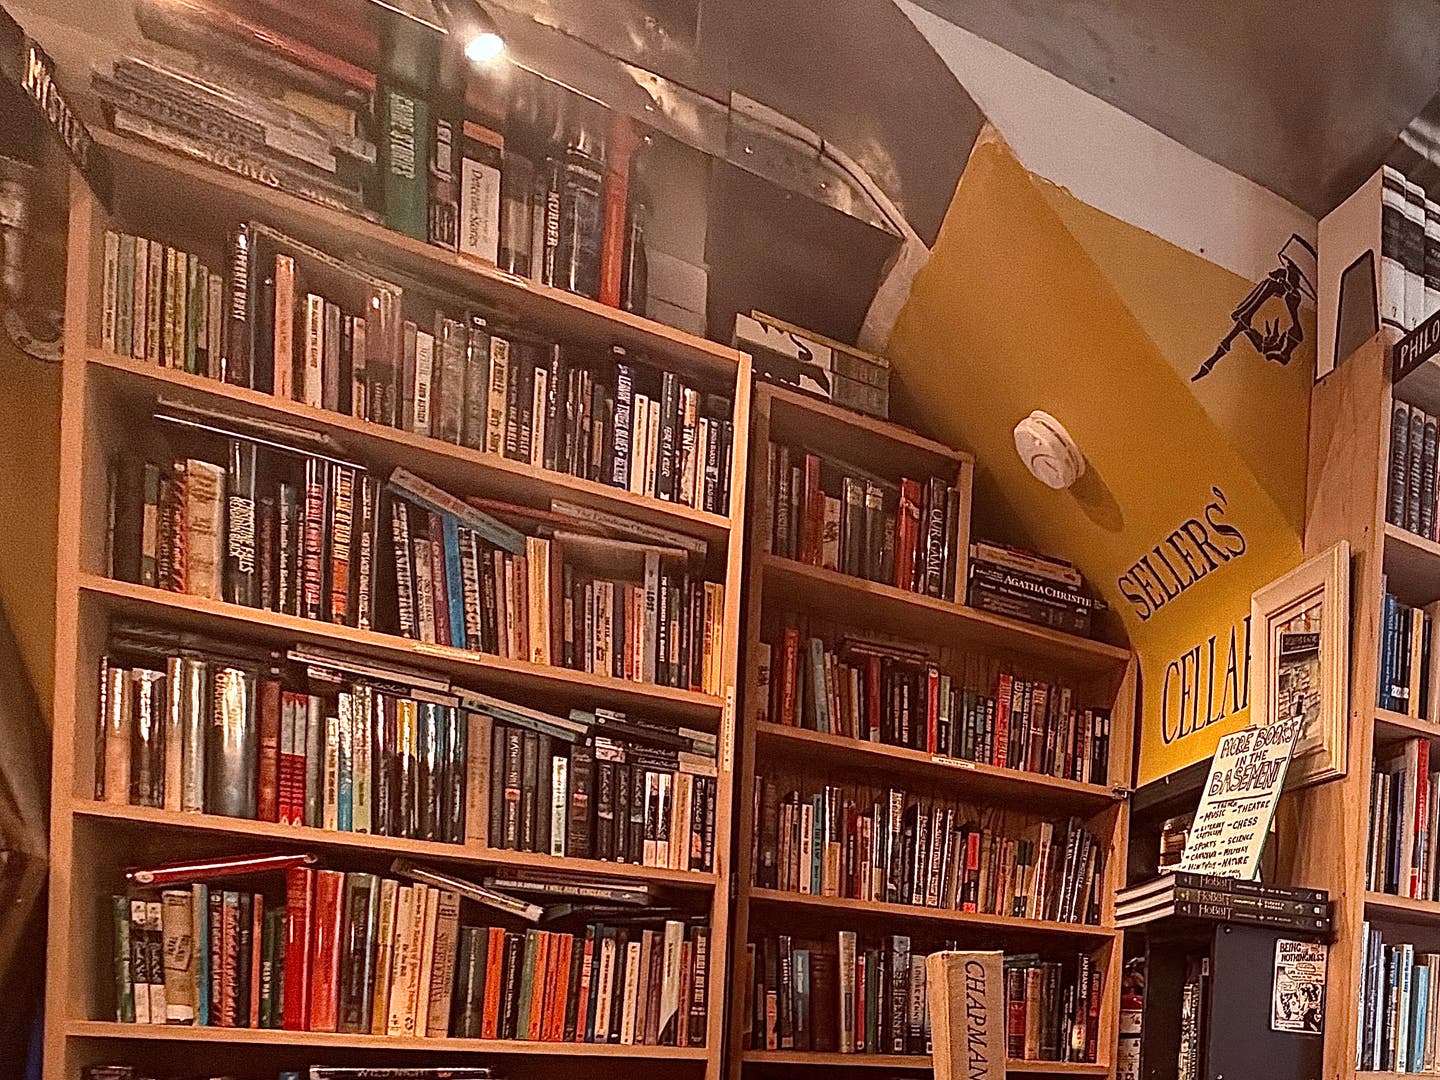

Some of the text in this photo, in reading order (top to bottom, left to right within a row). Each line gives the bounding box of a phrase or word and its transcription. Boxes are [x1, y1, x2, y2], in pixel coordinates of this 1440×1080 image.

[546, 191, 560, 246] MURDER
[681, 426, 696, 451] TINY
[928, 509, 942, 577] OUR GAME
[1118, 486, 1247, 621] SELLERS'
[238, 549, 255, 574] FALLS
[465, 557, 481, 635] BRANSON
[646, 591, 657, 612] LOST
[1003, 575, 1092, 607] AGATHA CHRISTIE
[1220, 720, 1299, 759] MORE BOOKS
[1235, 749, 1268, 768] IN THE
[1208, 757, 1287, 797] BASEMENT
[1200, 875, 1235, 892] HOBBIT
[1197, 890, 1232, 906] HOBBIT
[1199, 904, 1233, 921] HOBBIT
[1279, 943, 1302, 953] BEING
[1281, 952, 1325, 963] NOTHINGNESS
[1080, 956, 1090, 999] IAN RANKIN
[911, 992, 923, 1025] PENNY
